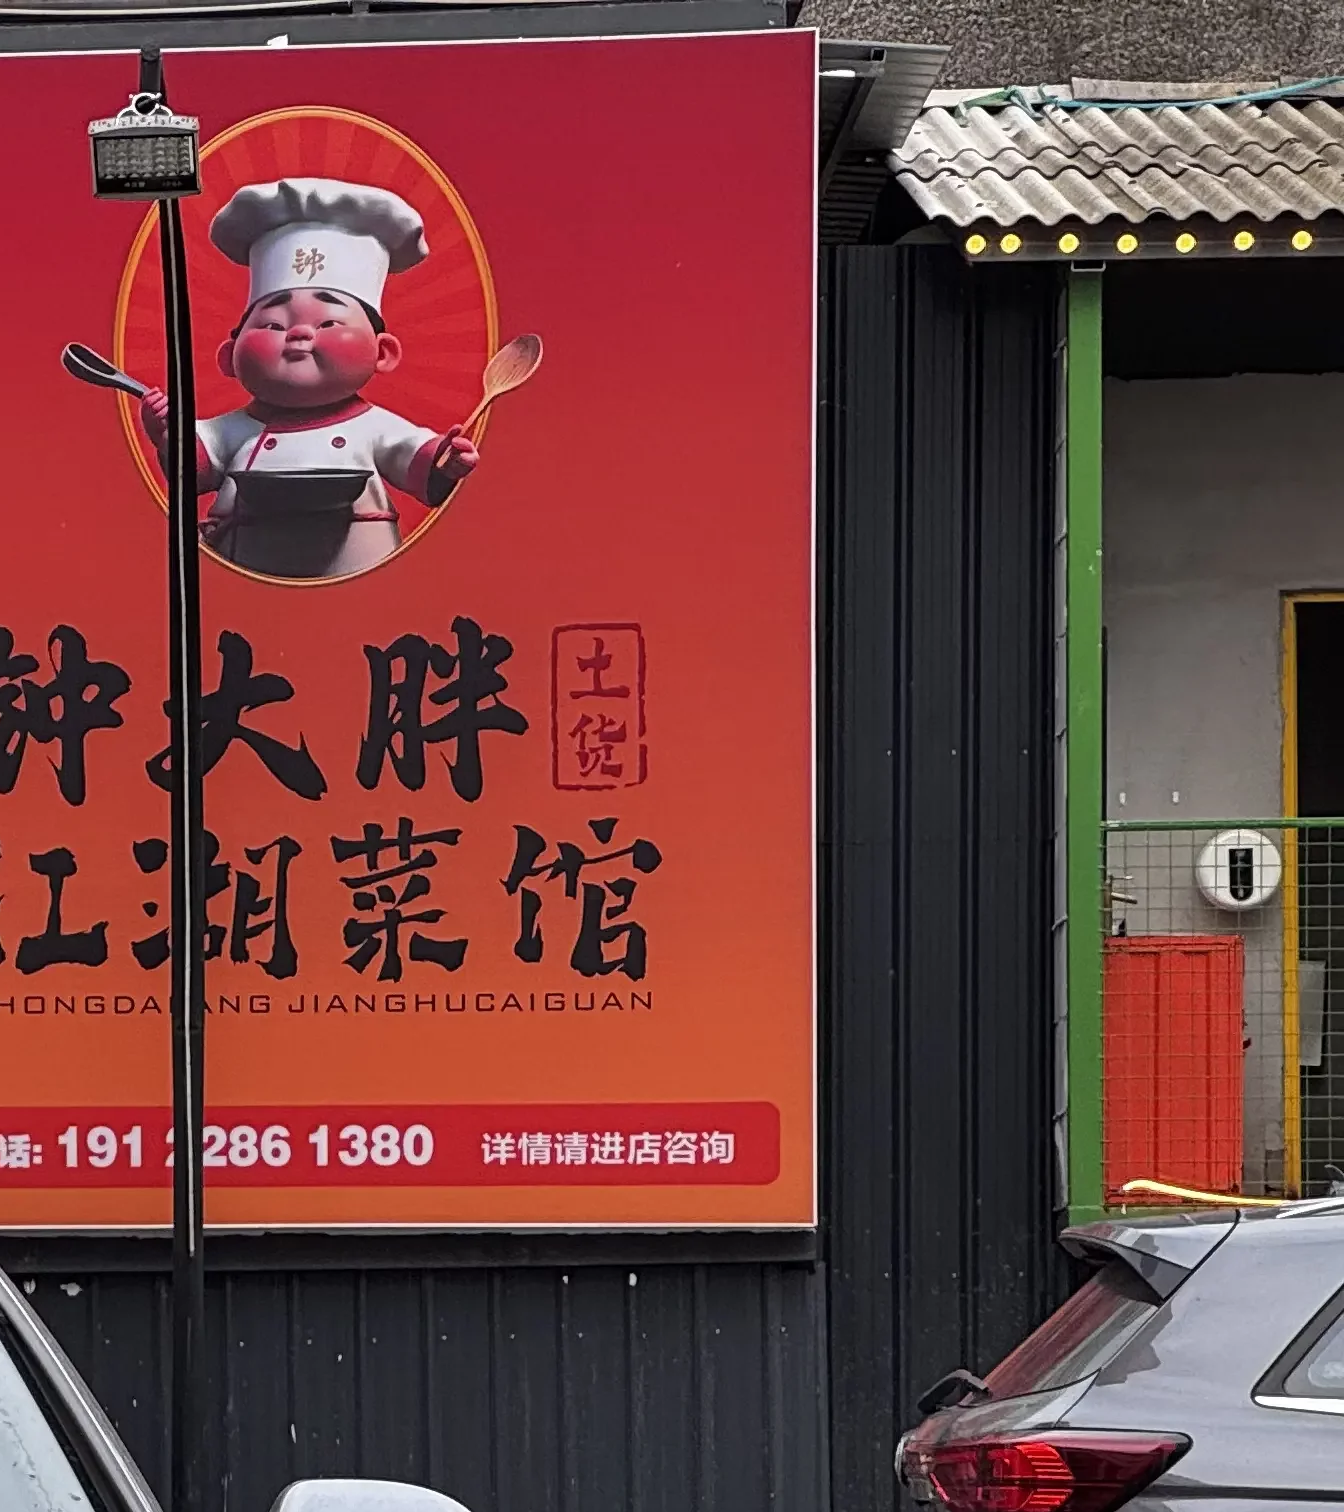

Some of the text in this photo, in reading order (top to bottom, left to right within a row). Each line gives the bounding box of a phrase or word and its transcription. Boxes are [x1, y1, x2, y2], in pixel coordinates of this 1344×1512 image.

[291, 246, 325, 283] 钟
[570, 637, 630, 779] 土货
[287, 990, 655, 1014] JIANGHUCAIGUAN
[58, 1125, 142, 1168] 191
[165, 1124, 292, 1168] 286
[308, 1123, 435, 1168] 1380
[480, 1131, 736, 1166] 详情请进店咨询
